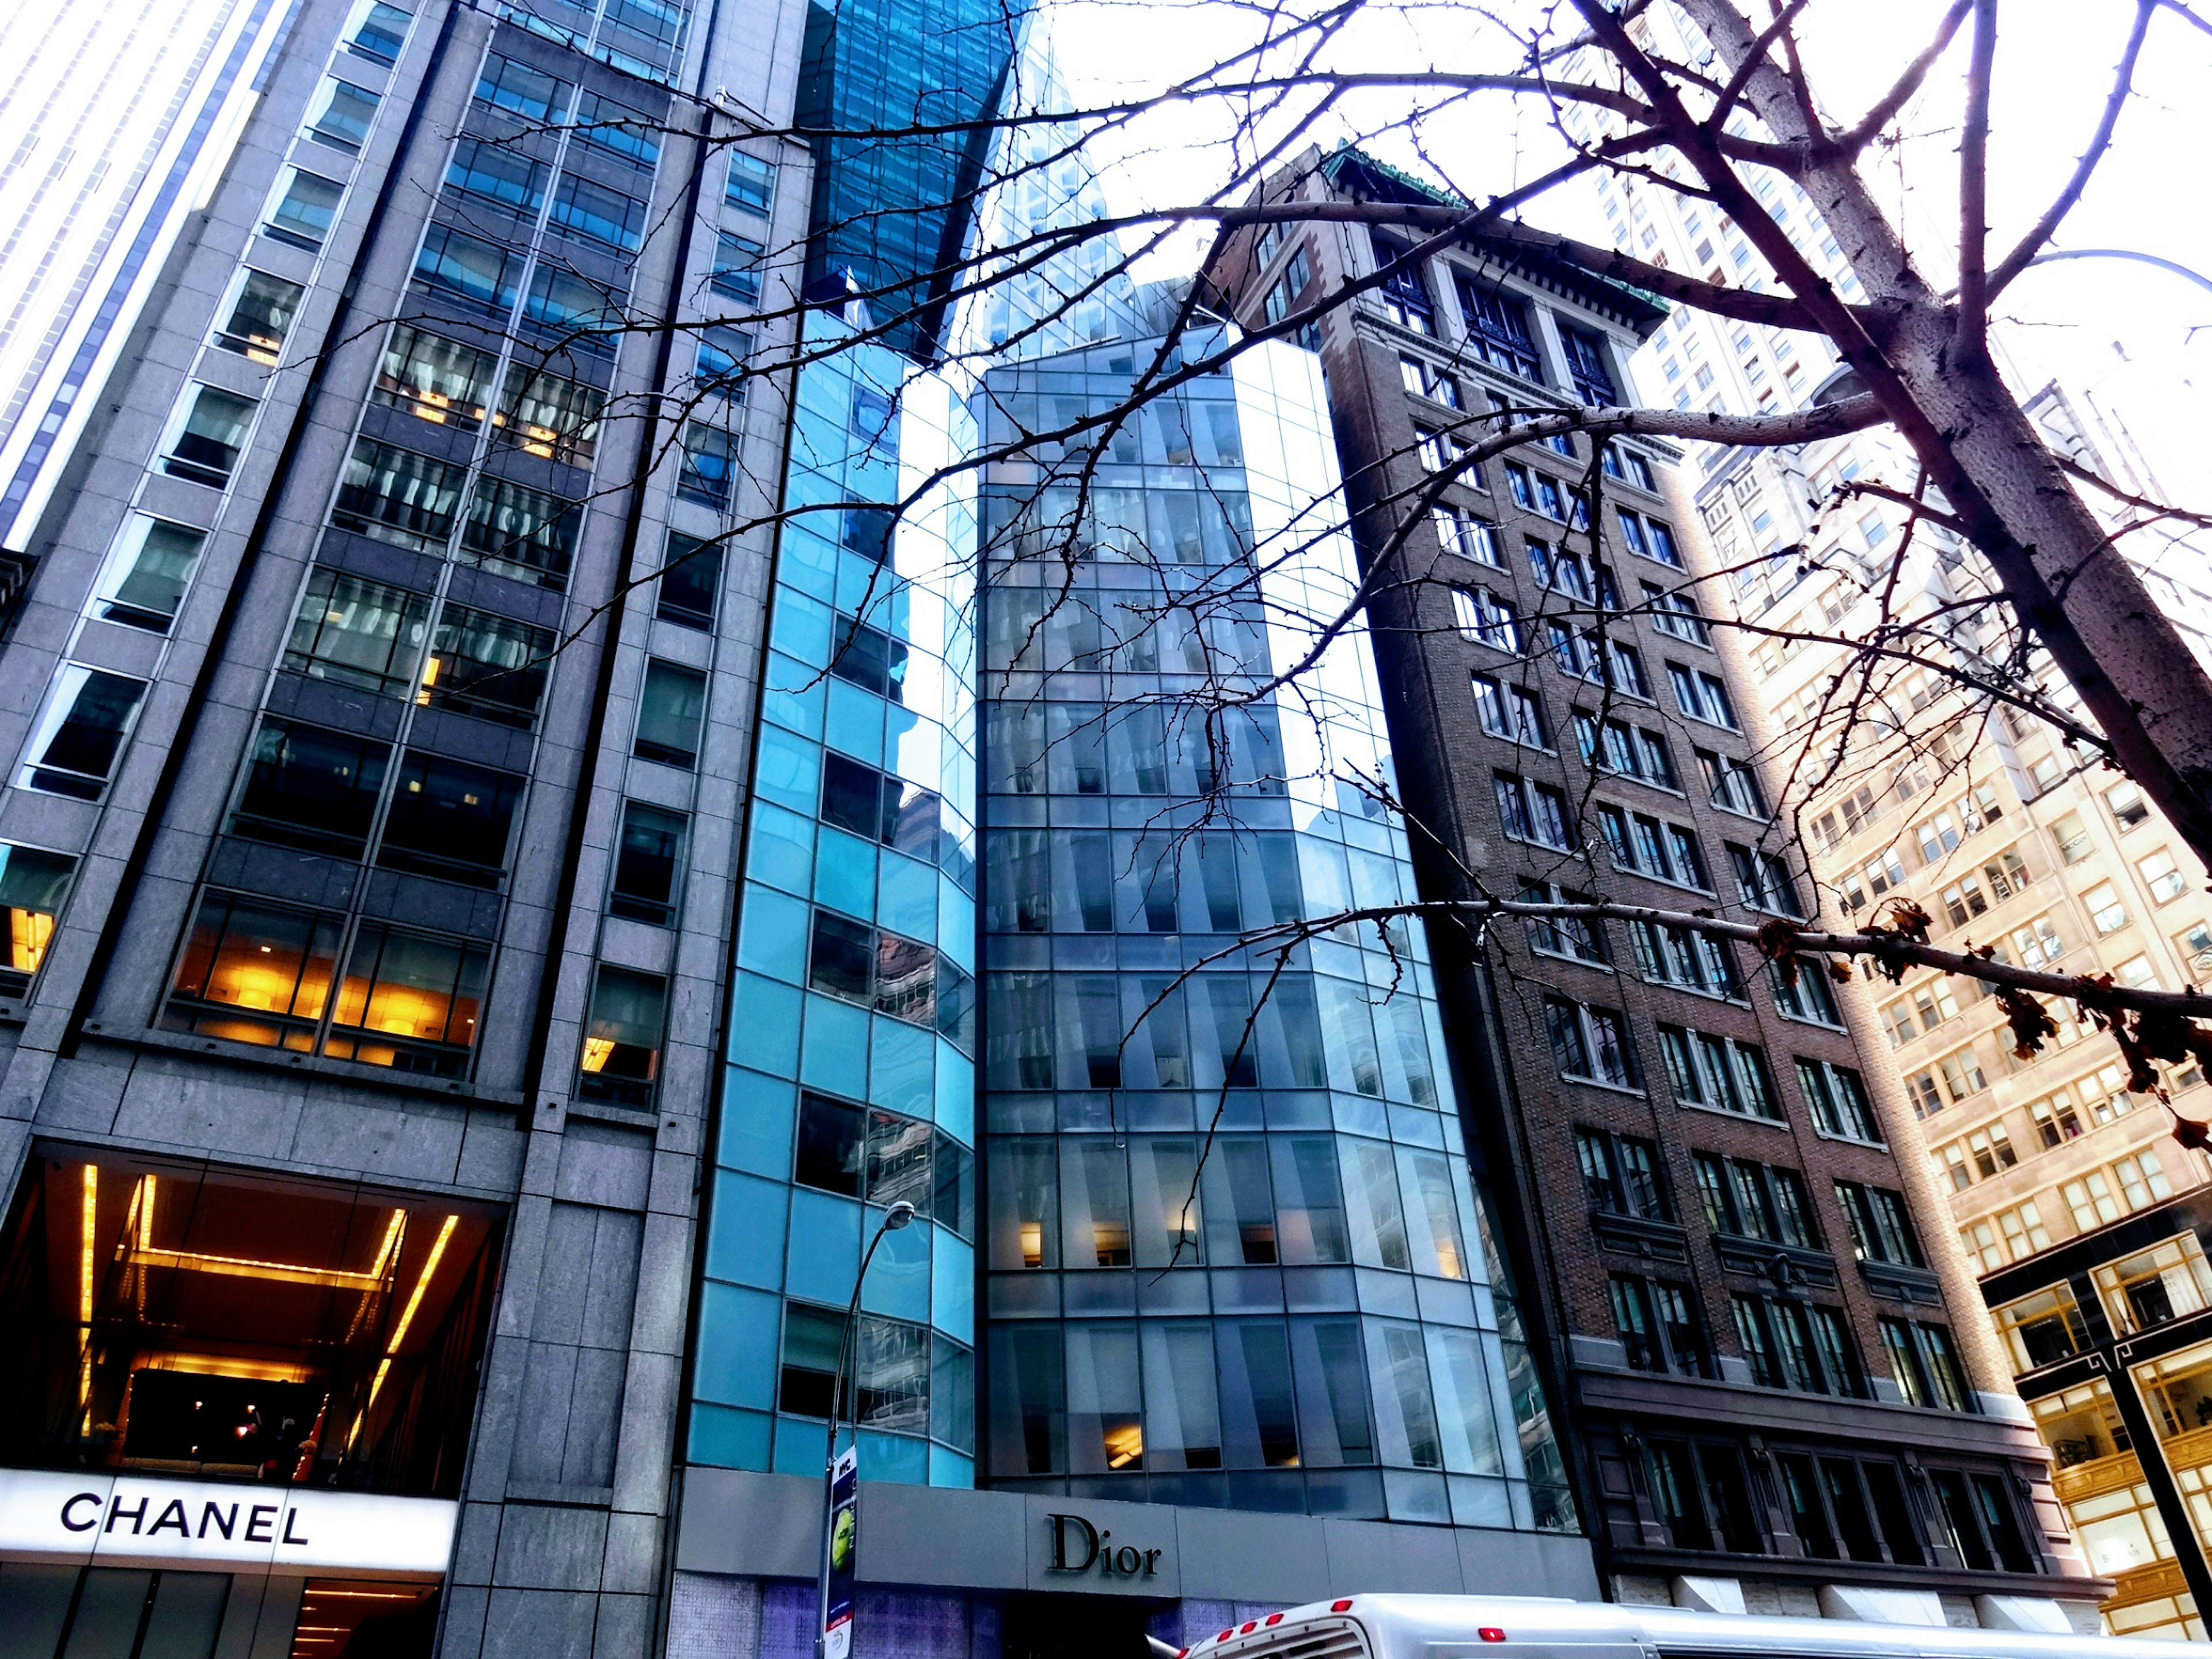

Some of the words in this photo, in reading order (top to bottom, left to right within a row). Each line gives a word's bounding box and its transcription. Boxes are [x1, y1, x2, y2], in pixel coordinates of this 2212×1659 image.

[839, 1457, 851, 1478] NYC
[60, 1493, 309, 1546] CHANEL
[1047, 1513, 1162, 1575] Dior
